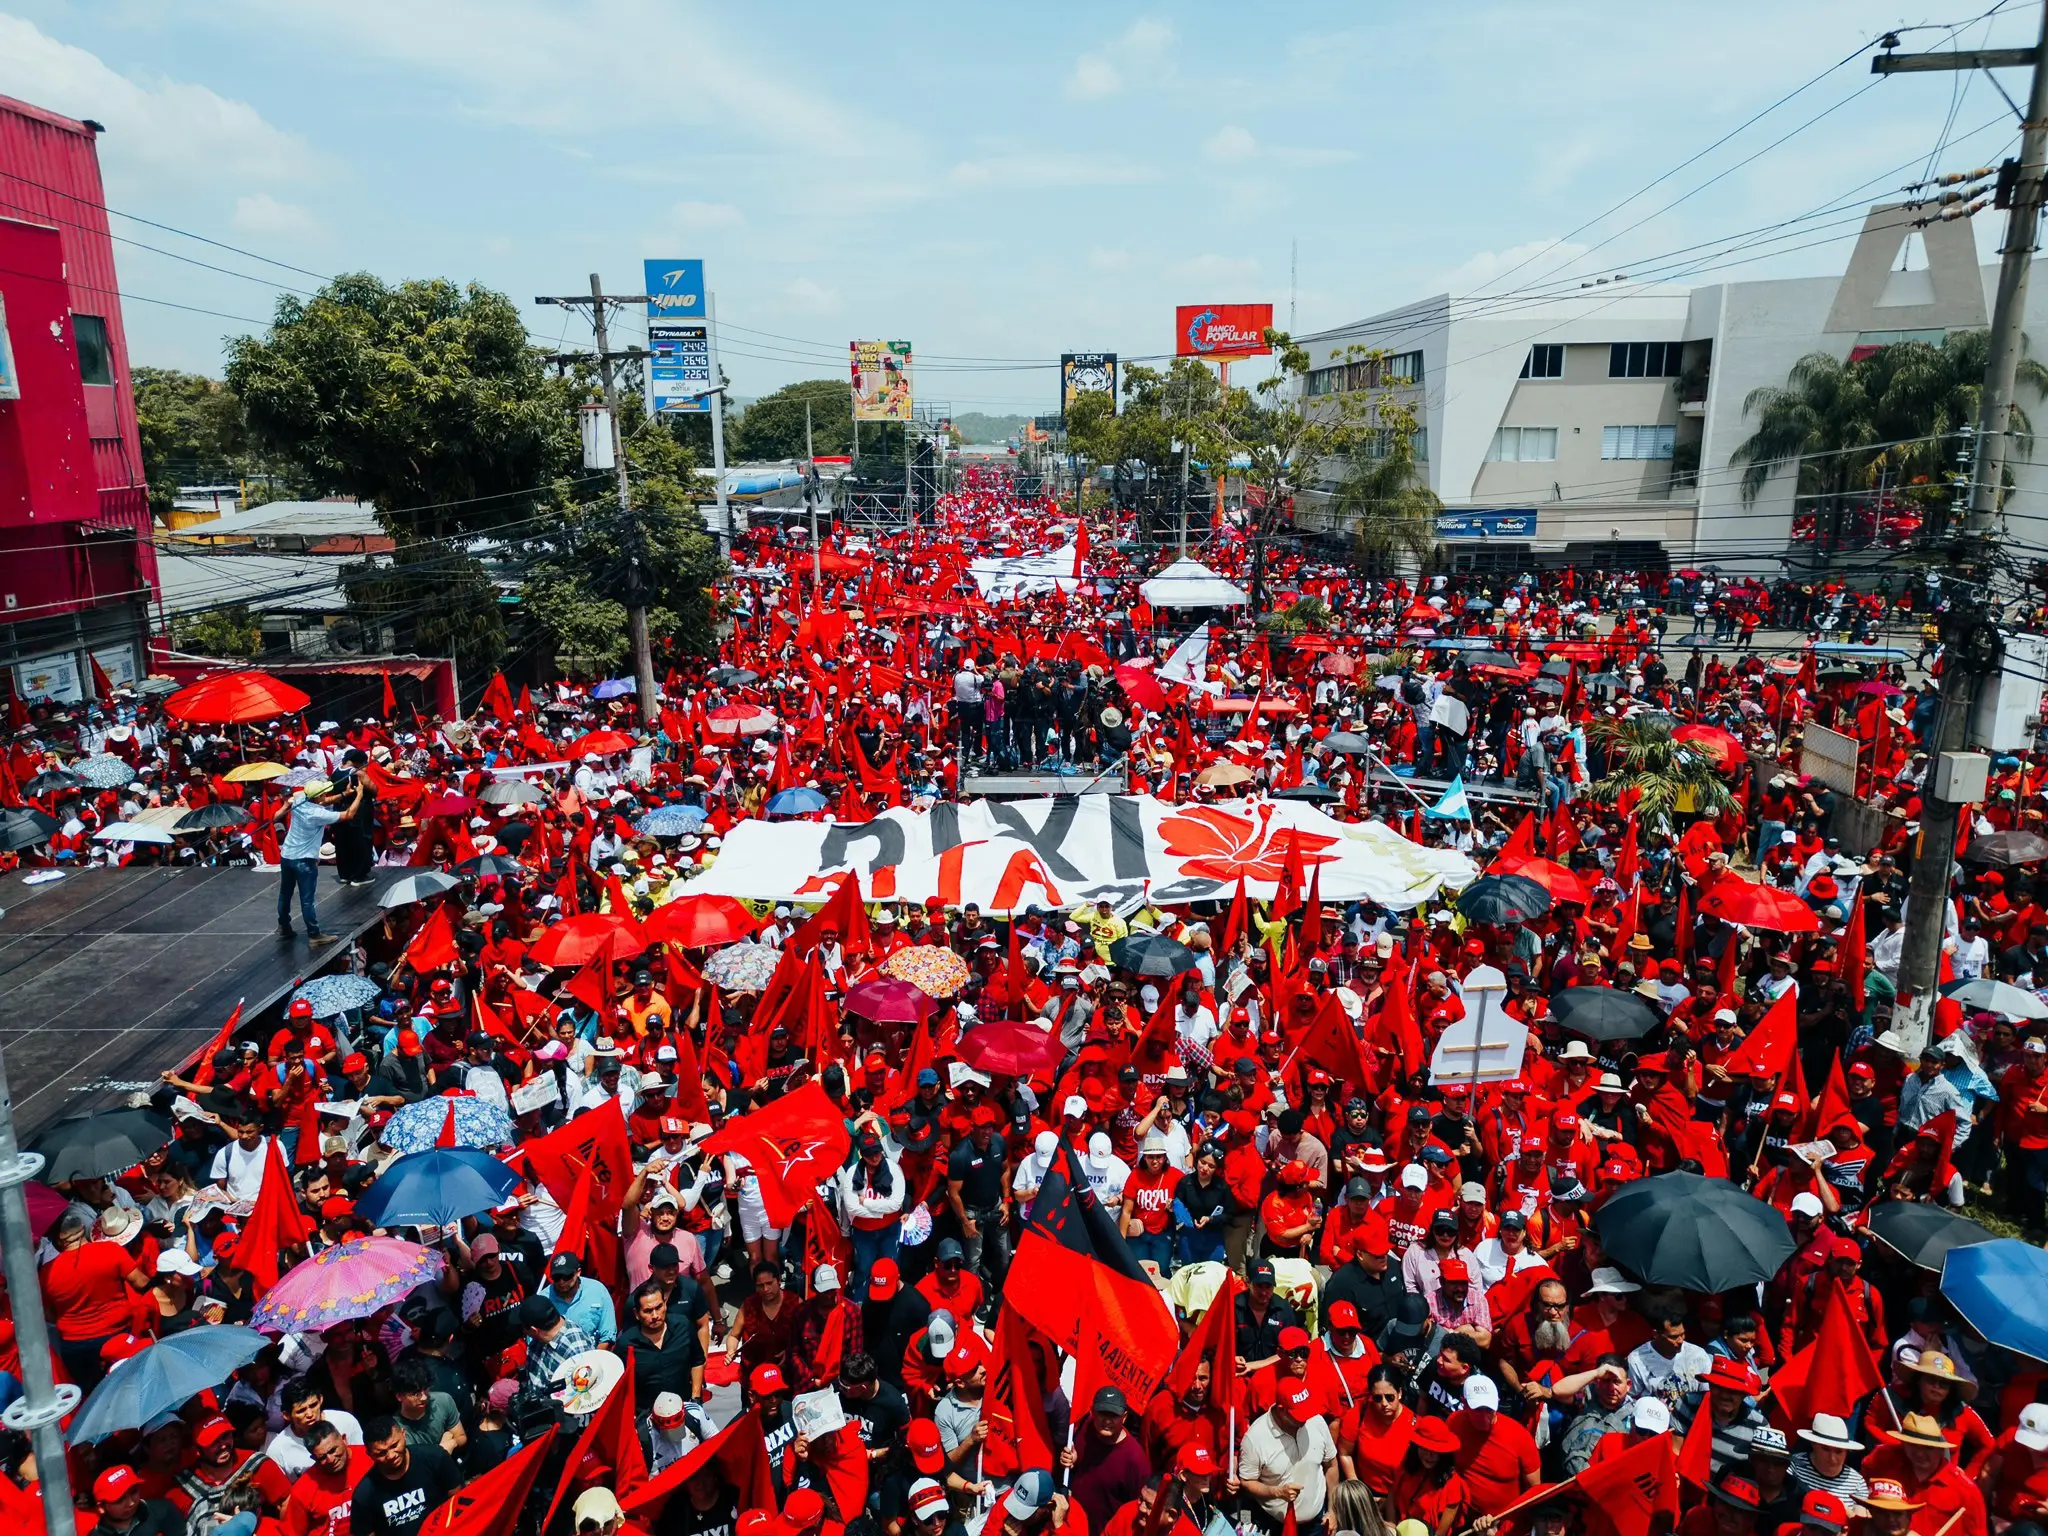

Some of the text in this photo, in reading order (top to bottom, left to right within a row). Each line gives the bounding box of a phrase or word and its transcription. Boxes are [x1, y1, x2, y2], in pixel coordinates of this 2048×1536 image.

[656, 294, 696, 307] UNO
[1206, 332, 1257, 341] POPULAR
[229, 858, 248, 867] RIXI
[1087, 1175, 1107, 1184] RIXI
[1389, 1218, 1426, 1235] Puerto
[1754, 1430, 1787, 1446] RIXI
[383, 1488, 426, 1516] RIXI
